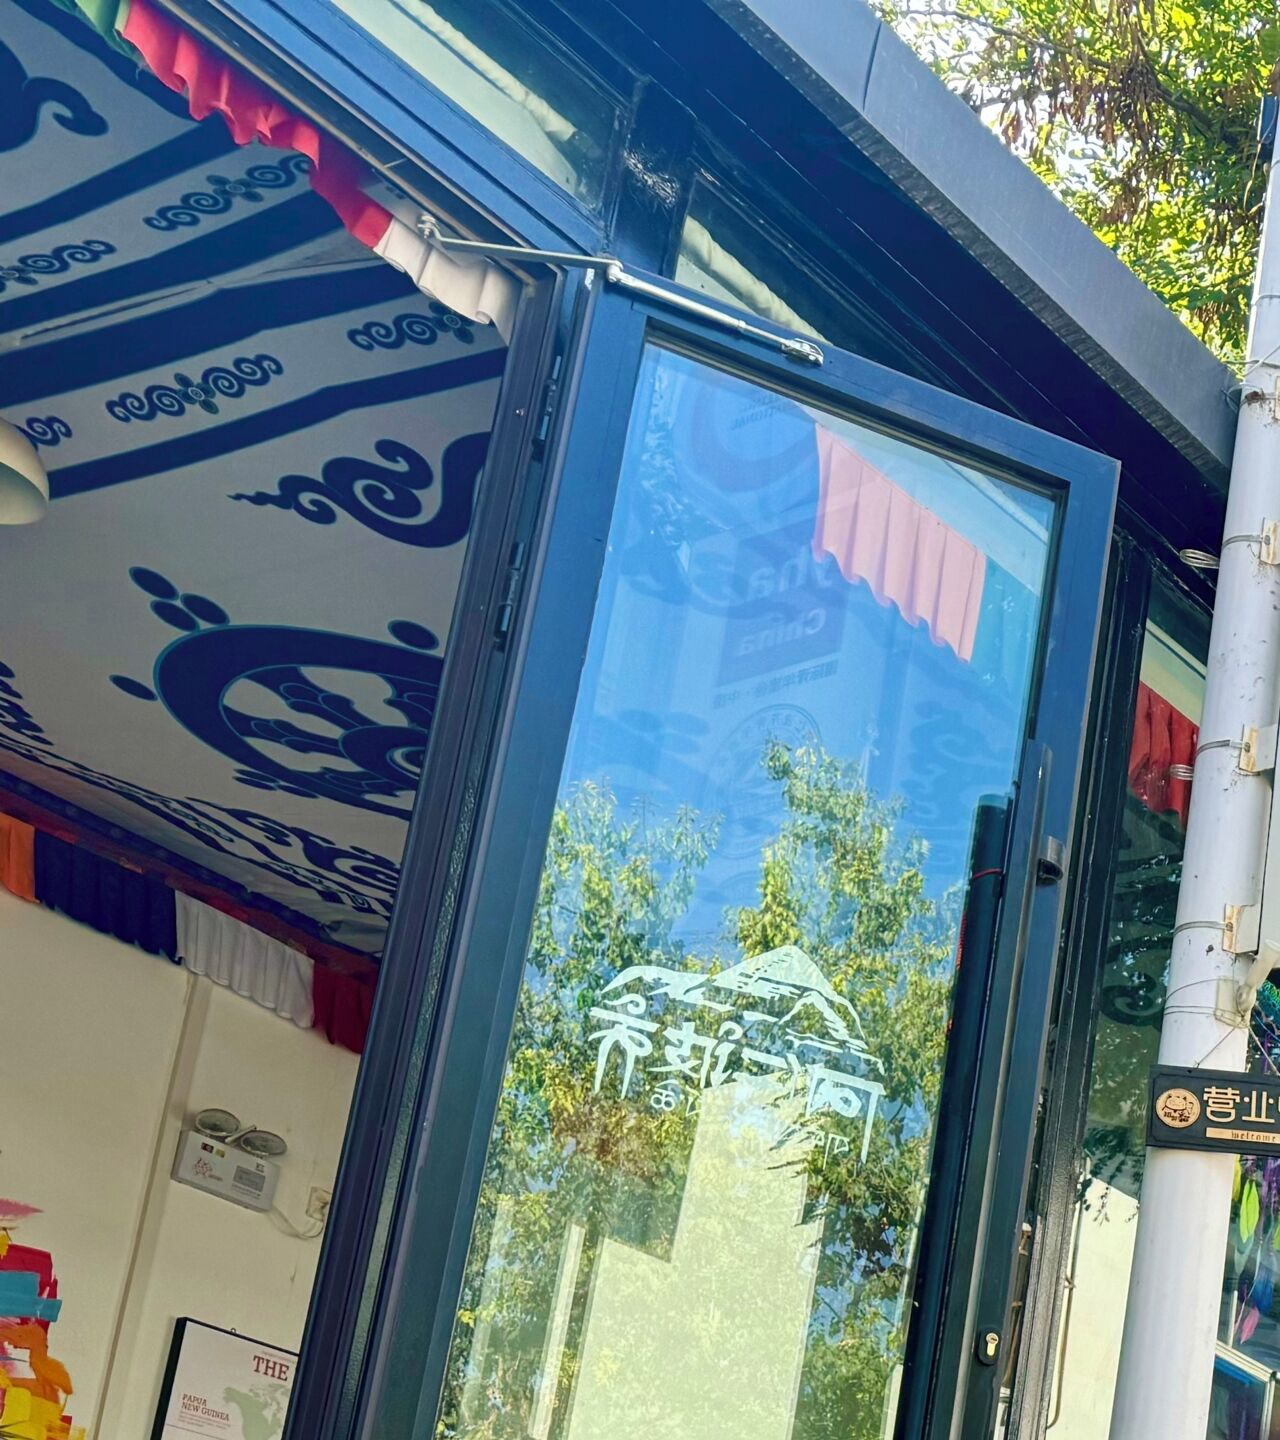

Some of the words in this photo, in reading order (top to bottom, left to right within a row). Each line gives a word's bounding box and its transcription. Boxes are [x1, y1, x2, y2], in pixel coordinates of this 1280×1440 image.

[253, 1354, 291, 1382] THE
[182, 1393, 208, 1407] PAPUA
[181, 1402, 199, 1415] NEW
[201, 1406, 230, 1422] GUINEA
